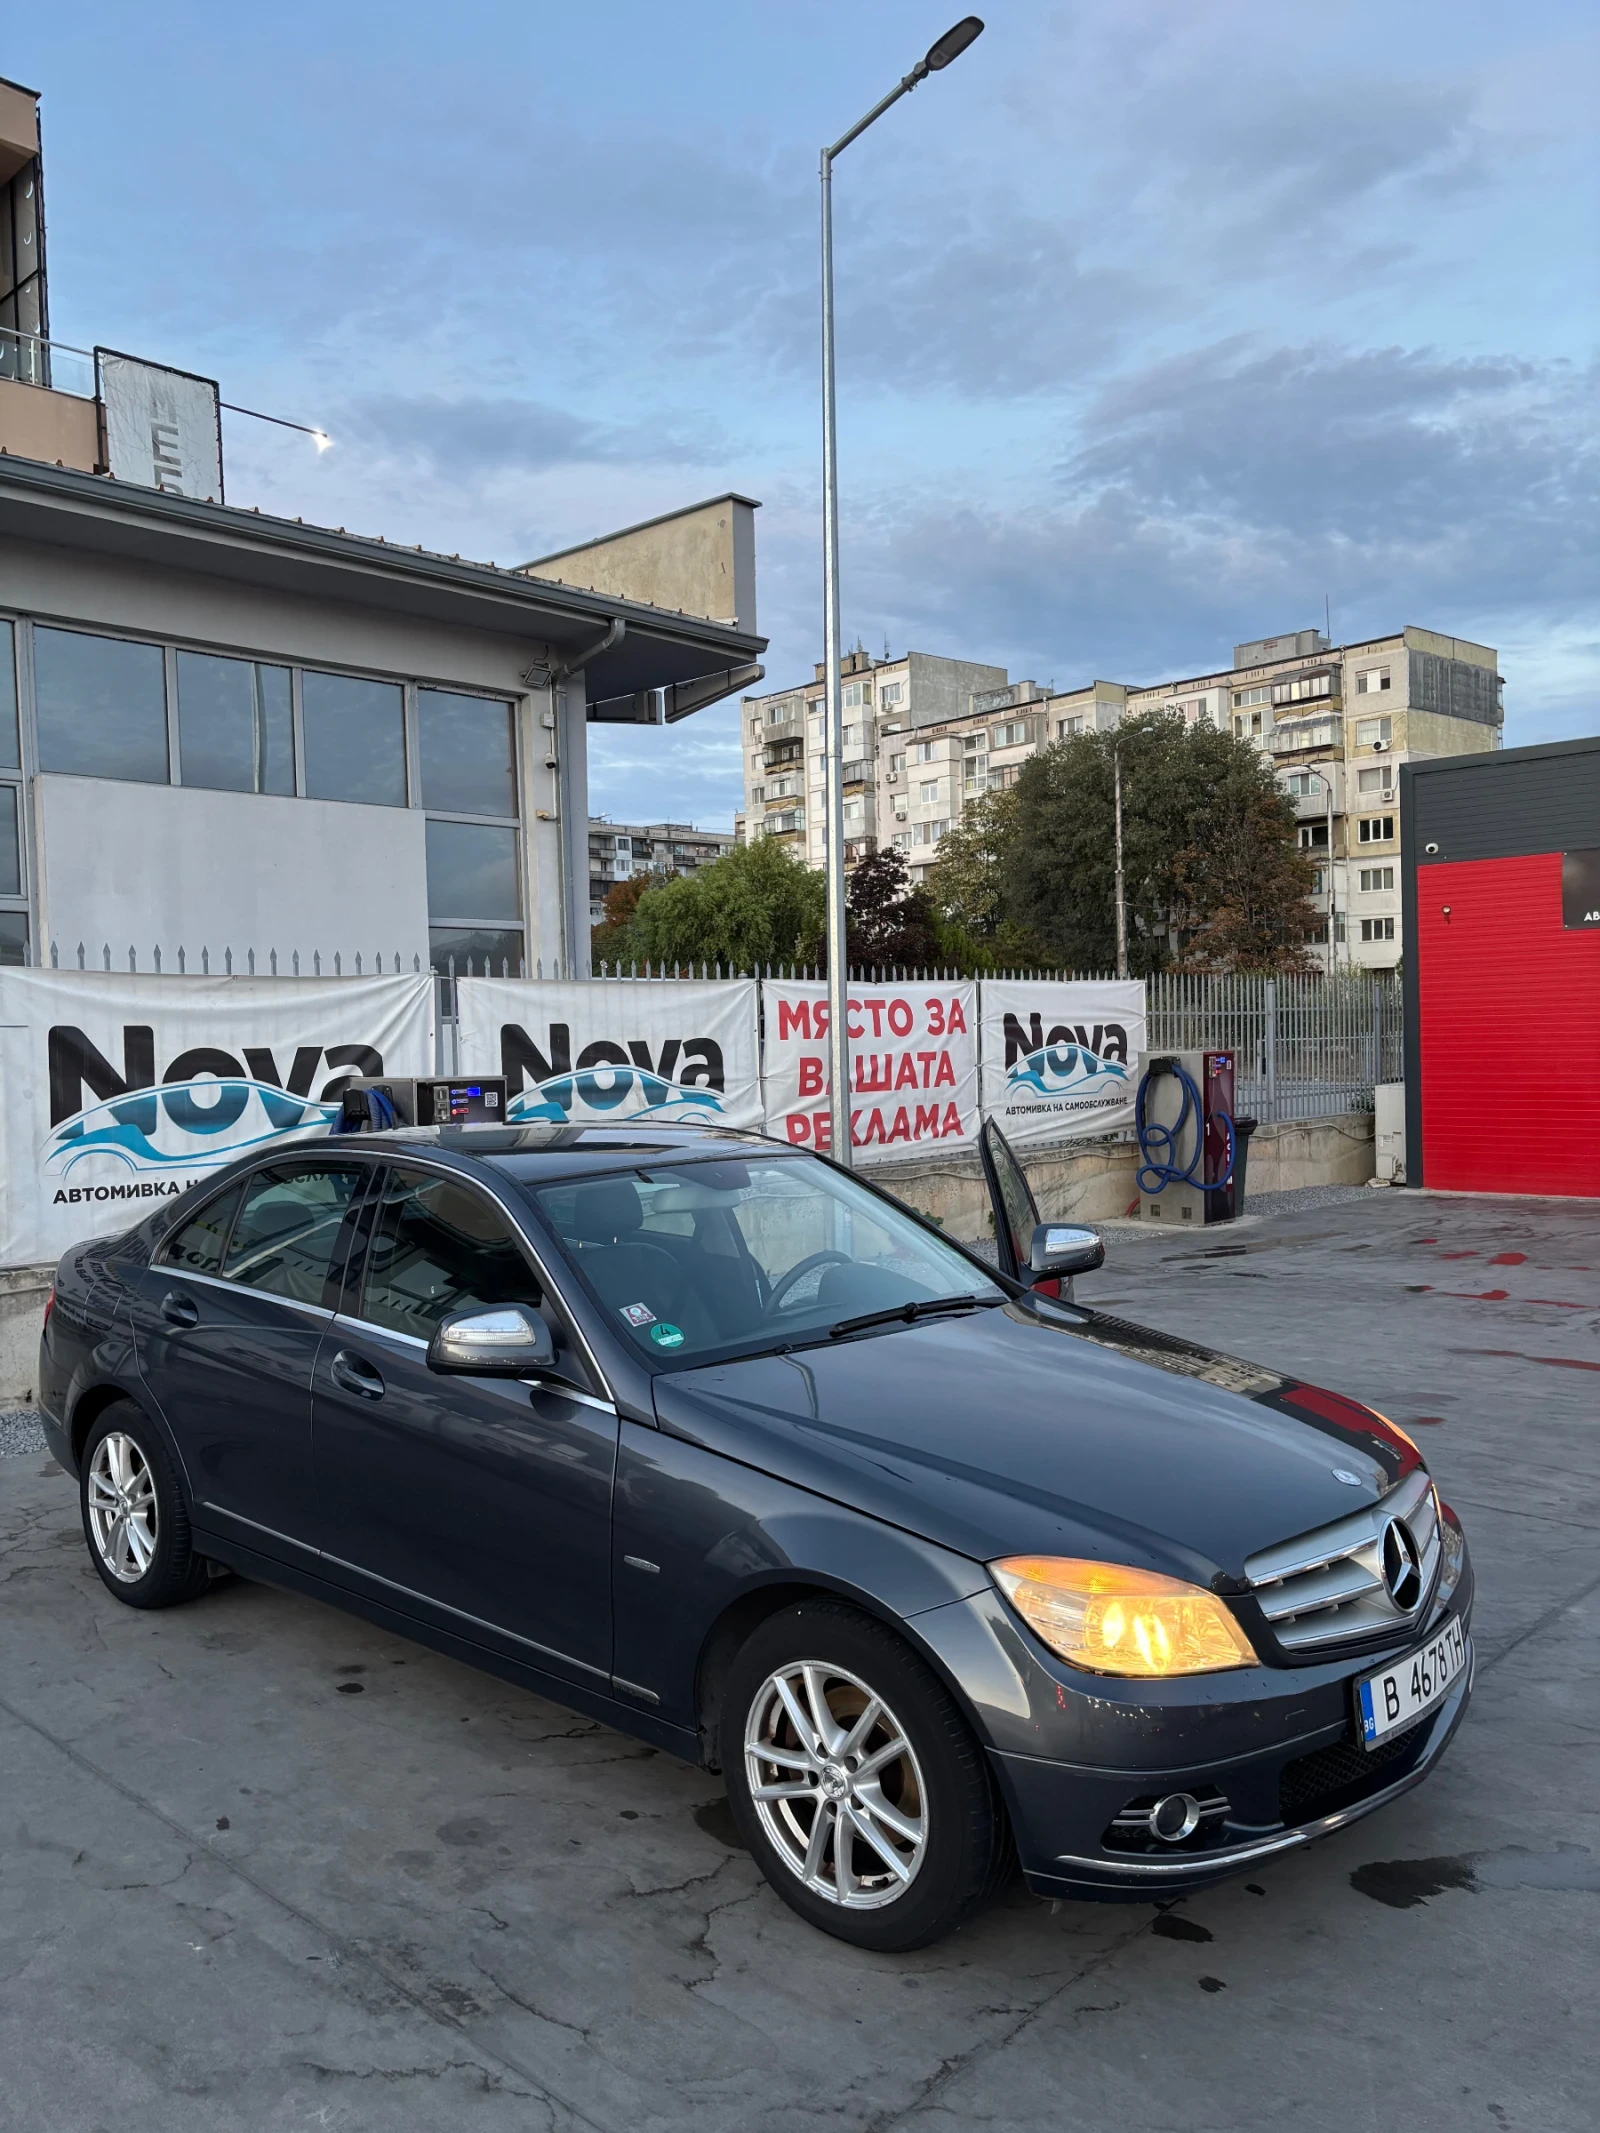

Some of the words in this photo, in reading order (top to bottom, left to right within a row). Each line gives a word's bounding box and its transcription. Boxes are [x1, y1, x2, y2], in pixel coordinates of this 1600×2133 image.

[778, 998, 914, 1041] МЯСТО
[925, 997, 967, 1036] ЗА
[500, 1023, 726, 1114] Nova
[1003, 1012, 1128, 1078] Nova
[48, 1025, 385, 1139] Nova
[798, 1050, 956, 1097] ВШАТА
[1005, 1103, 1052, 1116] АВТОМИВКА
[1053, 1103, 1064, 1112] НА
[1064, 1096, 1128, 1111] САМООБСЛУЖВАНЕ
[53, 1180, 180, 1204] АВТОМИВКА
[1383, 1675, 1399, 1722] B
[1410, 1641, 1448, 1703] 4678
[1364, 1718, 1375, 1733] BG
